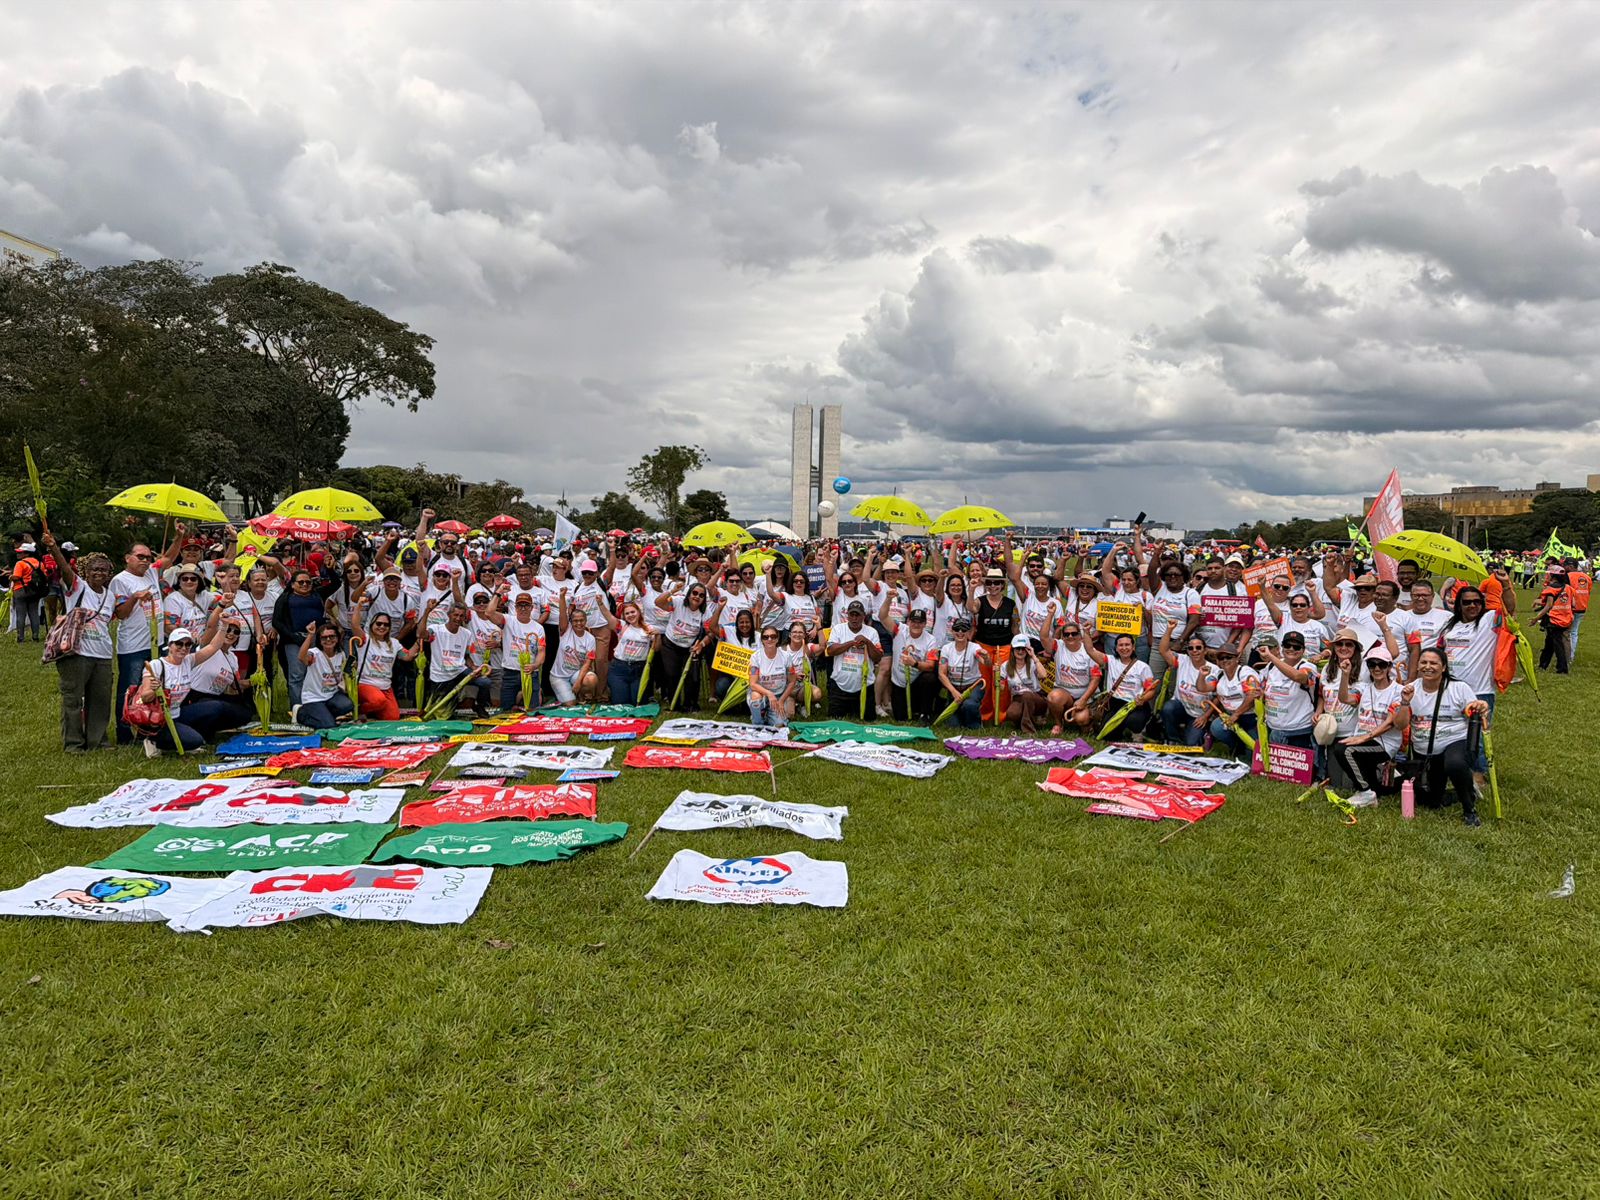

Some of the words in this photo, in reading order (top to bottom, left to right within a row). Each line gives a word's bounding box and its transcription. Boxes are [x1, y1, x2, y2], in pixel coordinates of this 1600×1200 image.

[294, 531, 321, 540] KIBON
[1104, 605, 1128, 613] CONFISCO
[1222, 600, 1249, 608] EDUCAÇÃO
[724, 646, 747, 658] CONFISCO
[716, 652, 750, 666] APOSENTADOS/
[732, 664, 747, 673] JUSTO
[1256, 752, 1279, 765] PÚICA,
[1279, 758, 1309, 771] CONCURSO
[1278, 749, 1306, 762] EDUCAÇÃO
[1269, 764, 1294, 776] PÚBLICO!
[227, 832, 350, 850] ACP
[250, 867, 424, 894] CNTE
